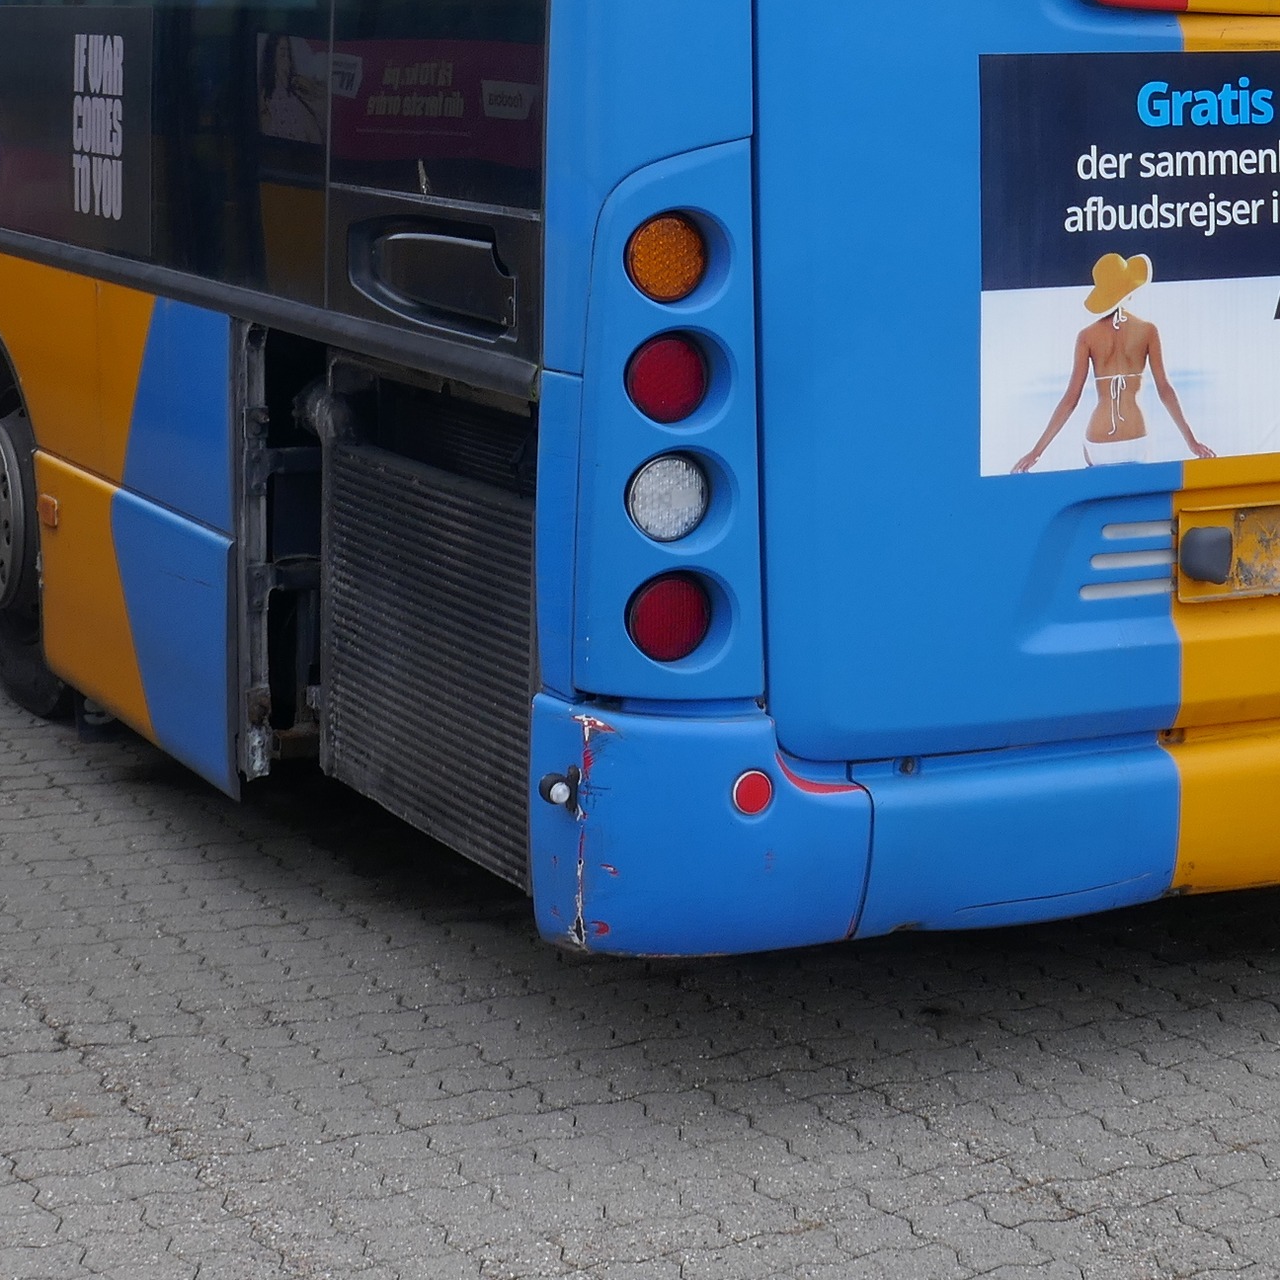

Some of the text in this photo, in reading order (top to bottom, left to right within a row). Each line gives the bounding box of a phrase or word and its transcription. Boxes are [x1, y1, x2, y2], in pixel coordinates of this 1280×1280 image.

[73, 34, 124, 96] IF WAR
[72, 95, 123, 157] COMES
[1136, 76, 1275, 128] Gratis
[72, 153, 123, 220] TO YOU
[1076, 145, 1133, 180] der
[1064, 193, 1265, 237] afbudsrejser
[1271, 191, 1279, 223] i
